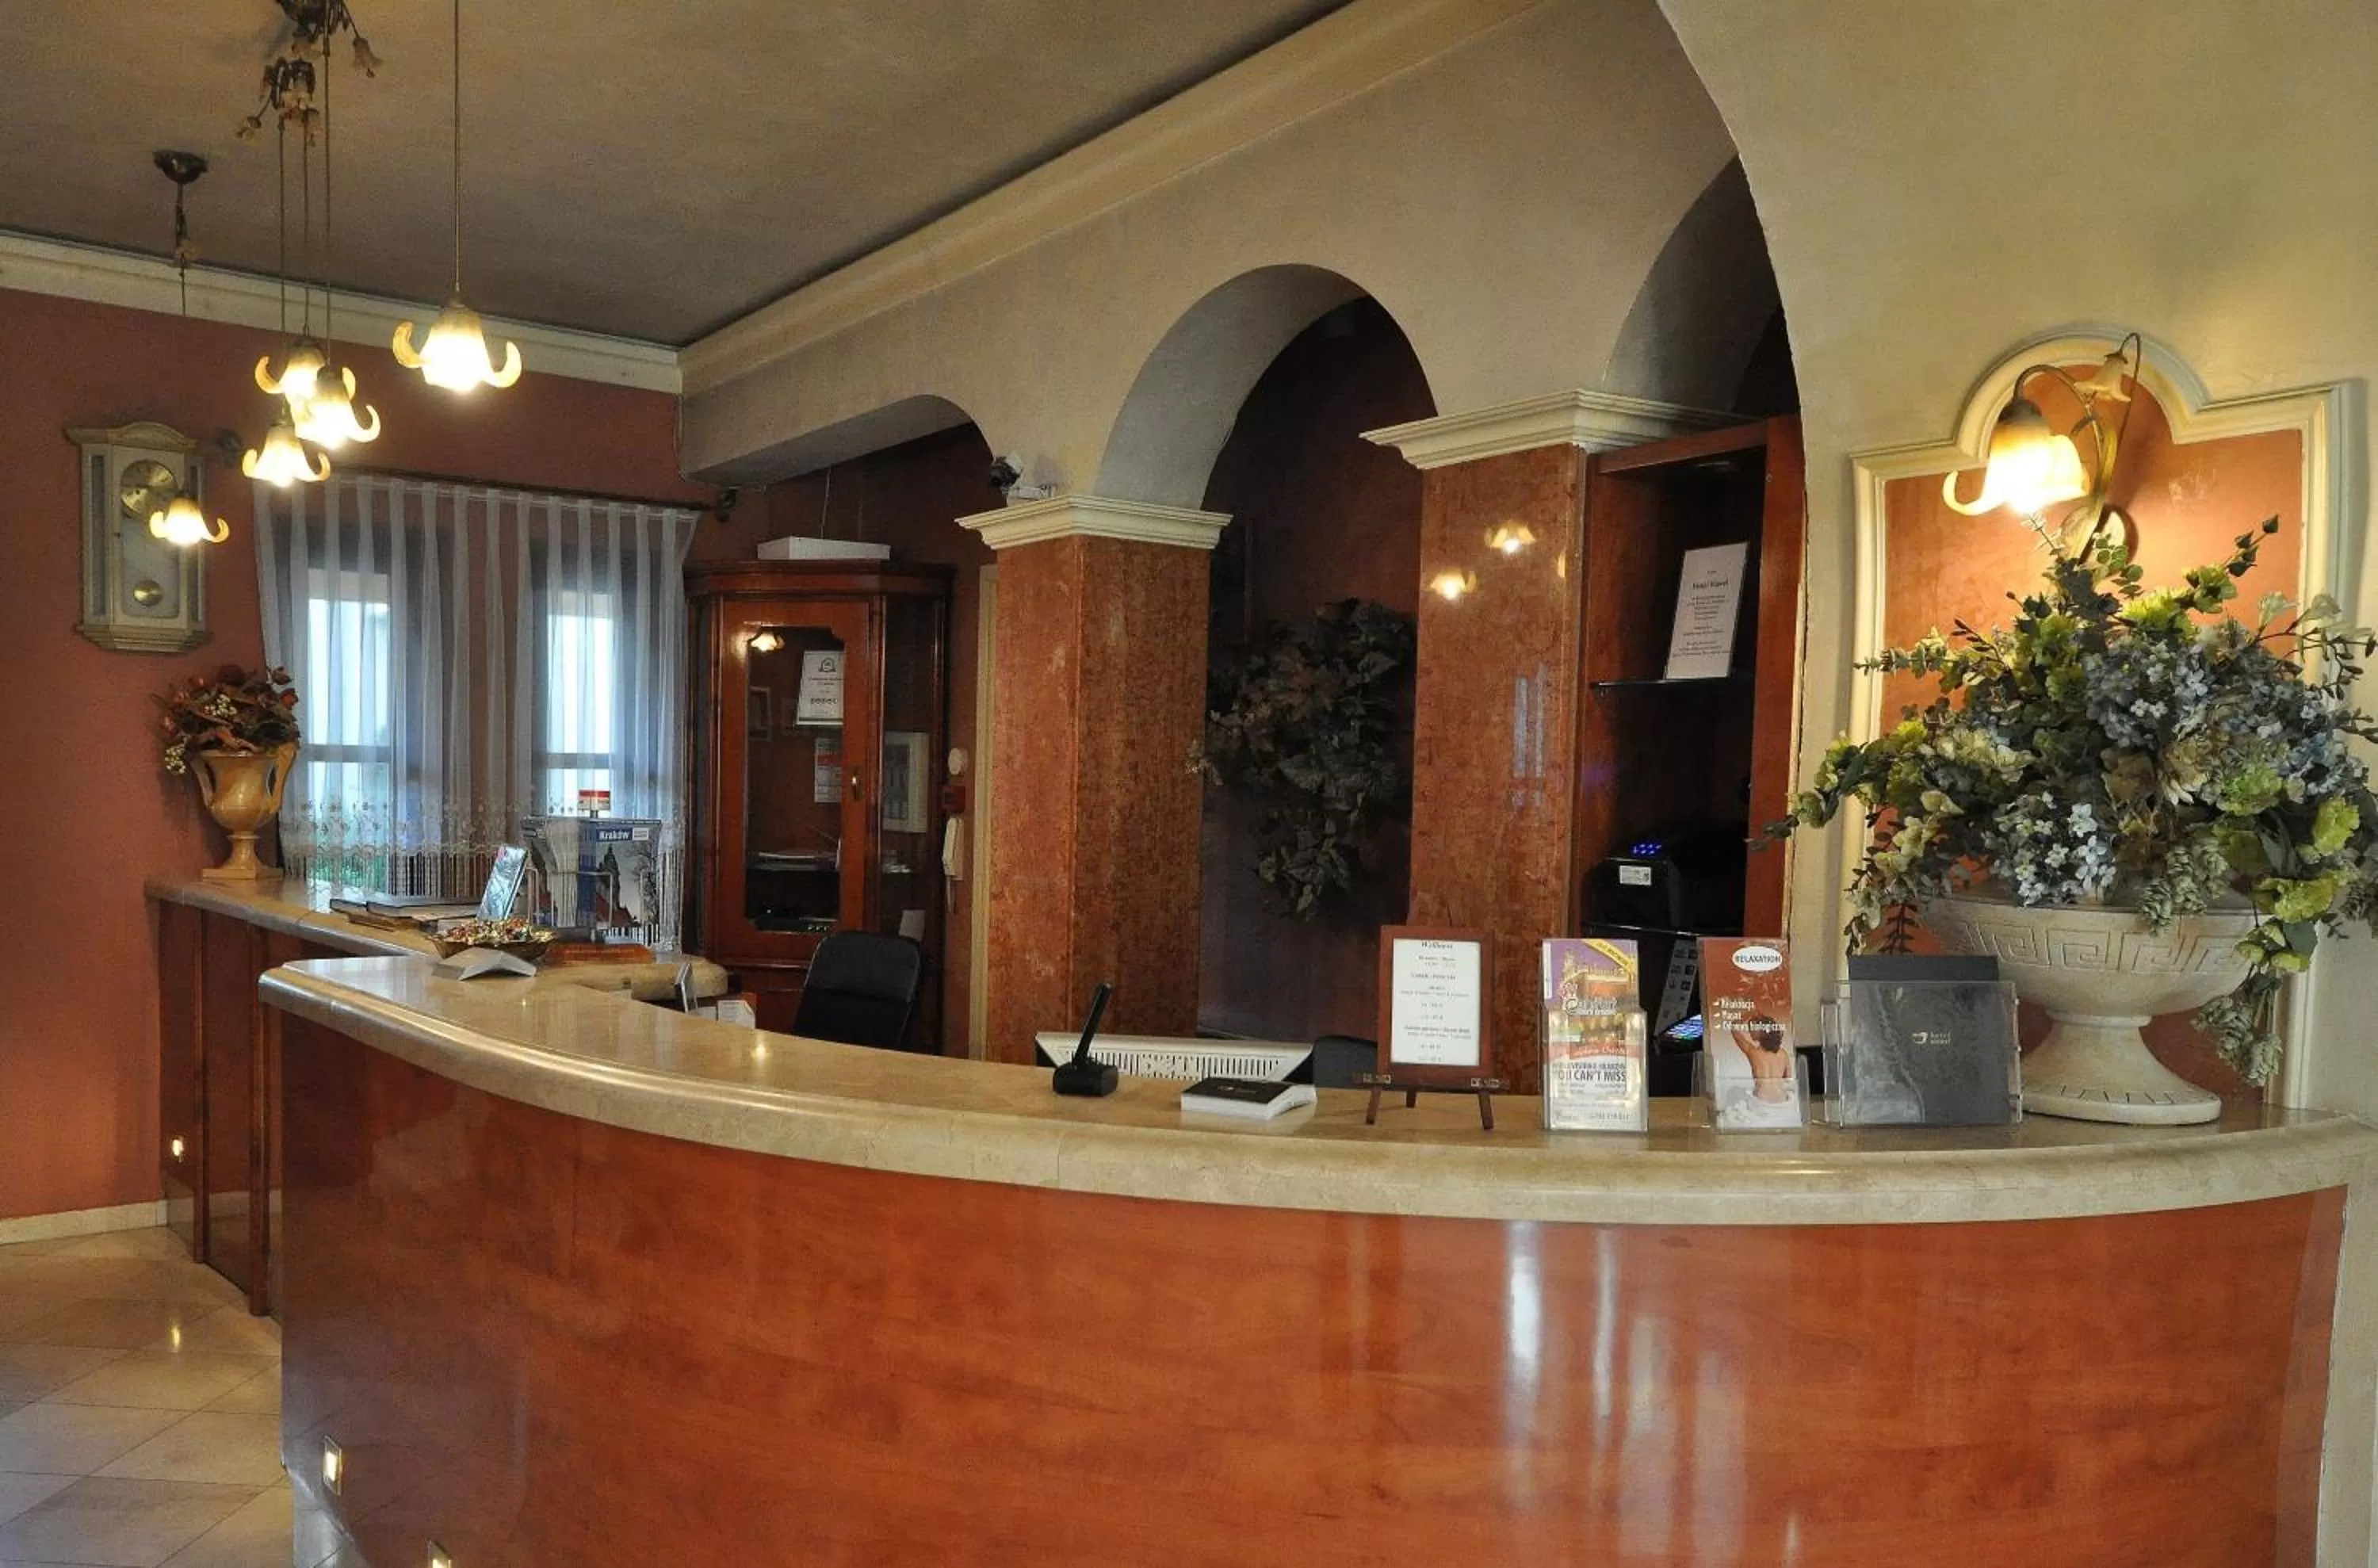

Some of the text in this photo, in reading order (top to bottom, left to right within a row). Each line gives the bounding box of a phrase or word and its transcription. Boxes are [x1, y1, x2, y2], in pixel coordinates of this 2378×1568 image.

[1735, 954, 1781, 963] RELAXATION
[1573, 1070, 1601, 1081] CAN'T
[1604, 1070, 1627, 1082] MISS
